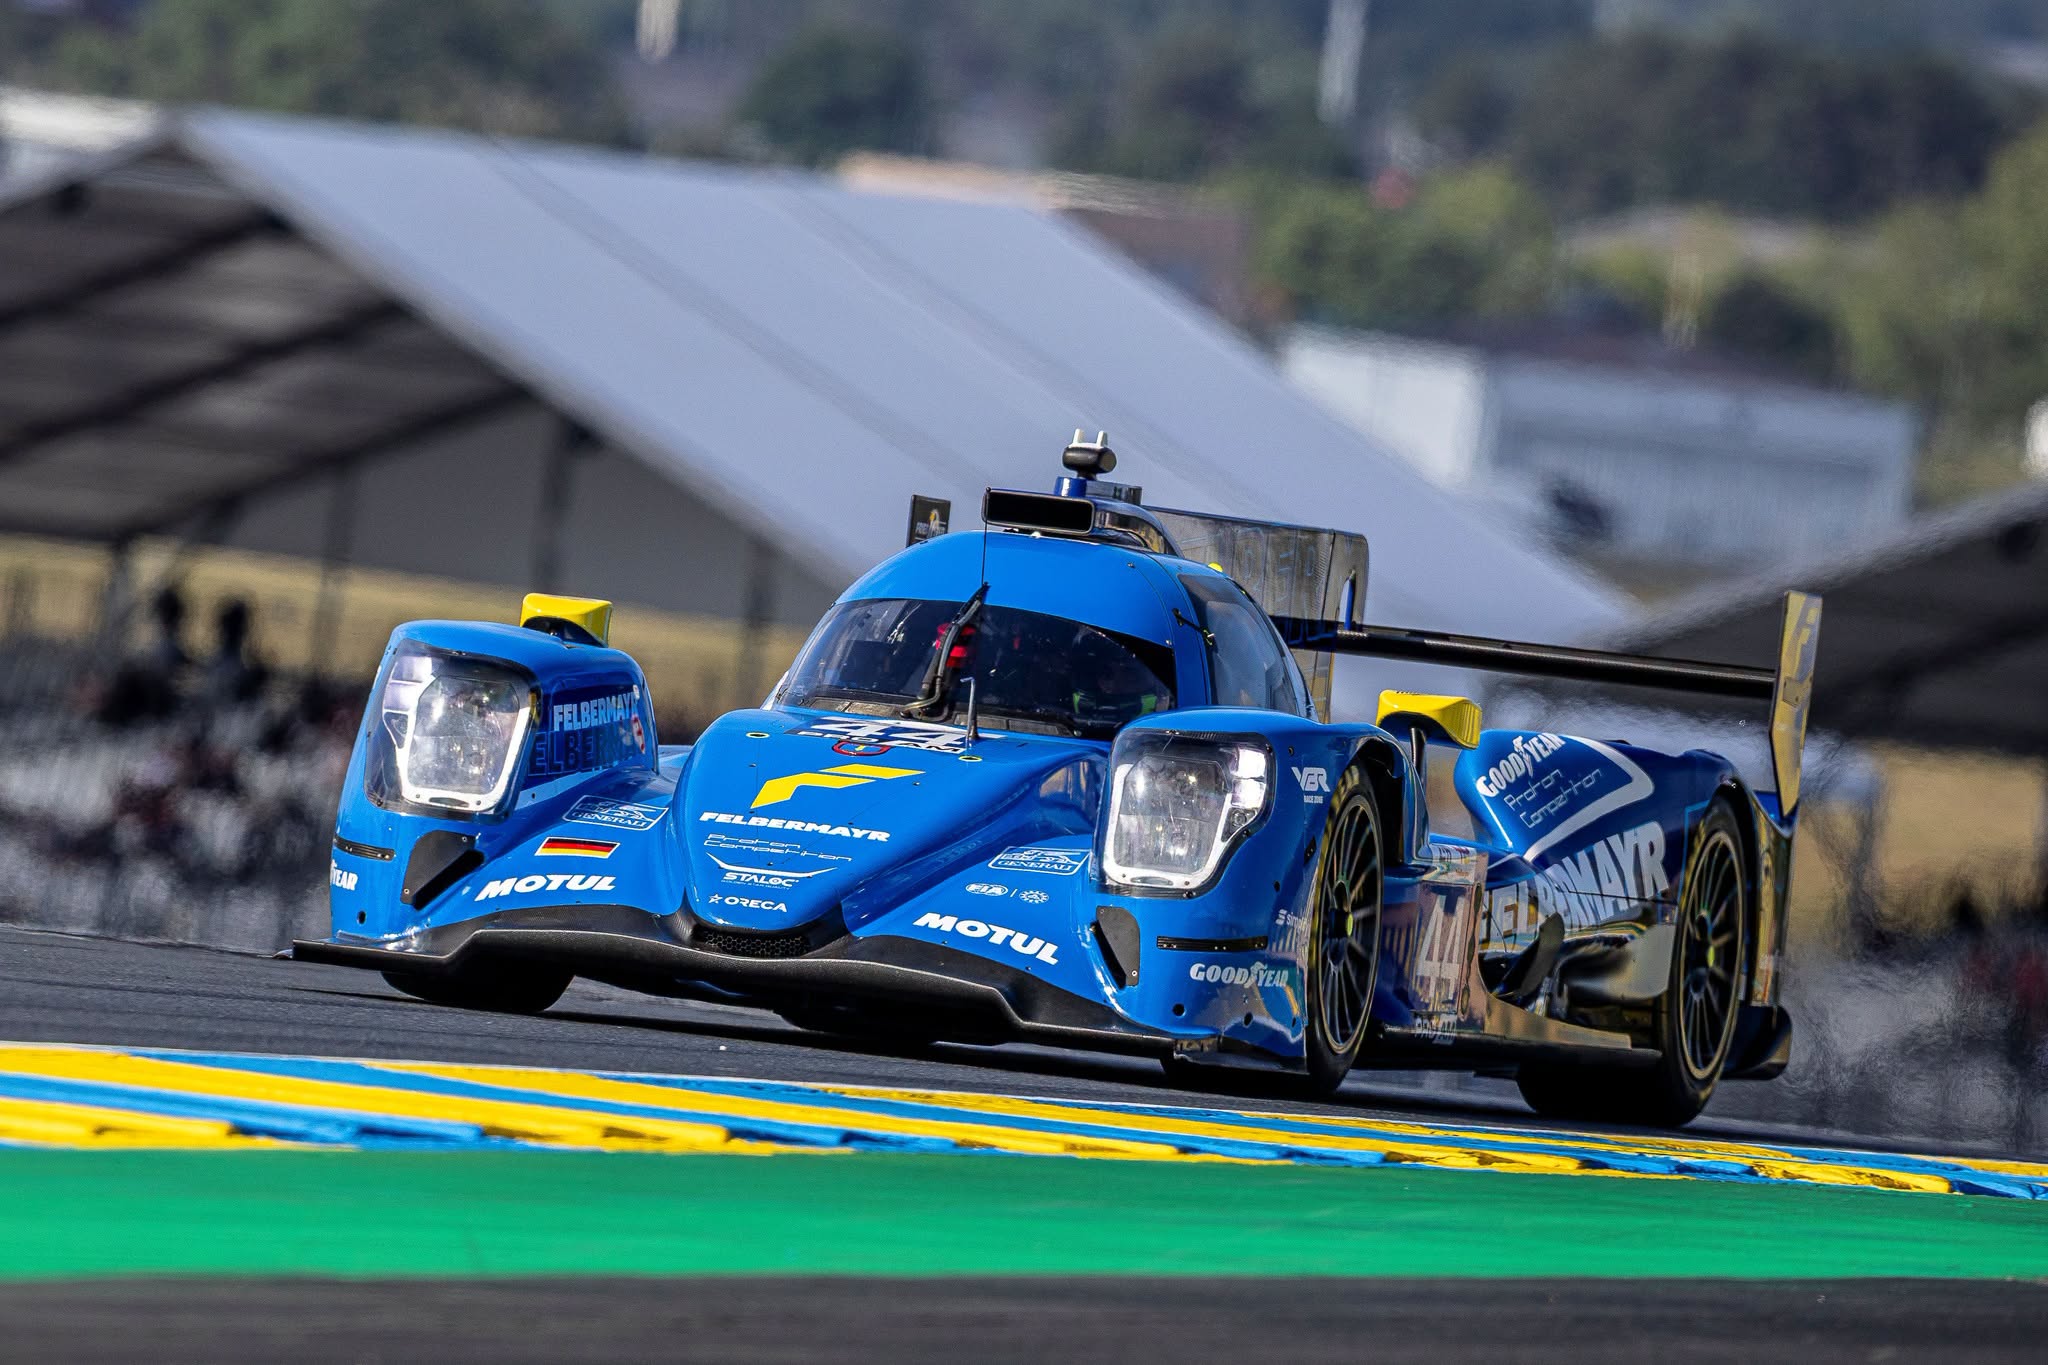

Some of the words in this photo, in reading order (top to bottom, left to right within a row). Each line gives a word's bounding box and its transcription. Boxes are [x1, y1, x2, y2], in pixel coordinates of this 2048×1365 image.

[553, 691, 639, 732] FELBERMAYR
[811, 716, 1007, 747] 44
[1476, 732, 1566, 797] GOODYEAR
[1503, 768, 1564, 811] Proton
[1519, 768, 1602, 829] Competition
[572, 812, 647, 828] GENERALI
[699, 812, 890, 843] FELBERMAYR
[703, 840, 853, 862] Competition
[707, 833, 801, 848] Proton
[330, 863, 359, 891] YEAR
[723, 872, 798, 888] STALOC
[998, 860, 1073, 872] GENERALI
[474, 874, 617, 902] MOTUL
[966, 883, 1007, 896] FIA
[724, 896, 788, 913] ORECA
[912, 912, 1059, 966] MOTUL
[1415, 893, 1466, 1003] 44
[1189, 961, 1289, 989] GOODYEAR
